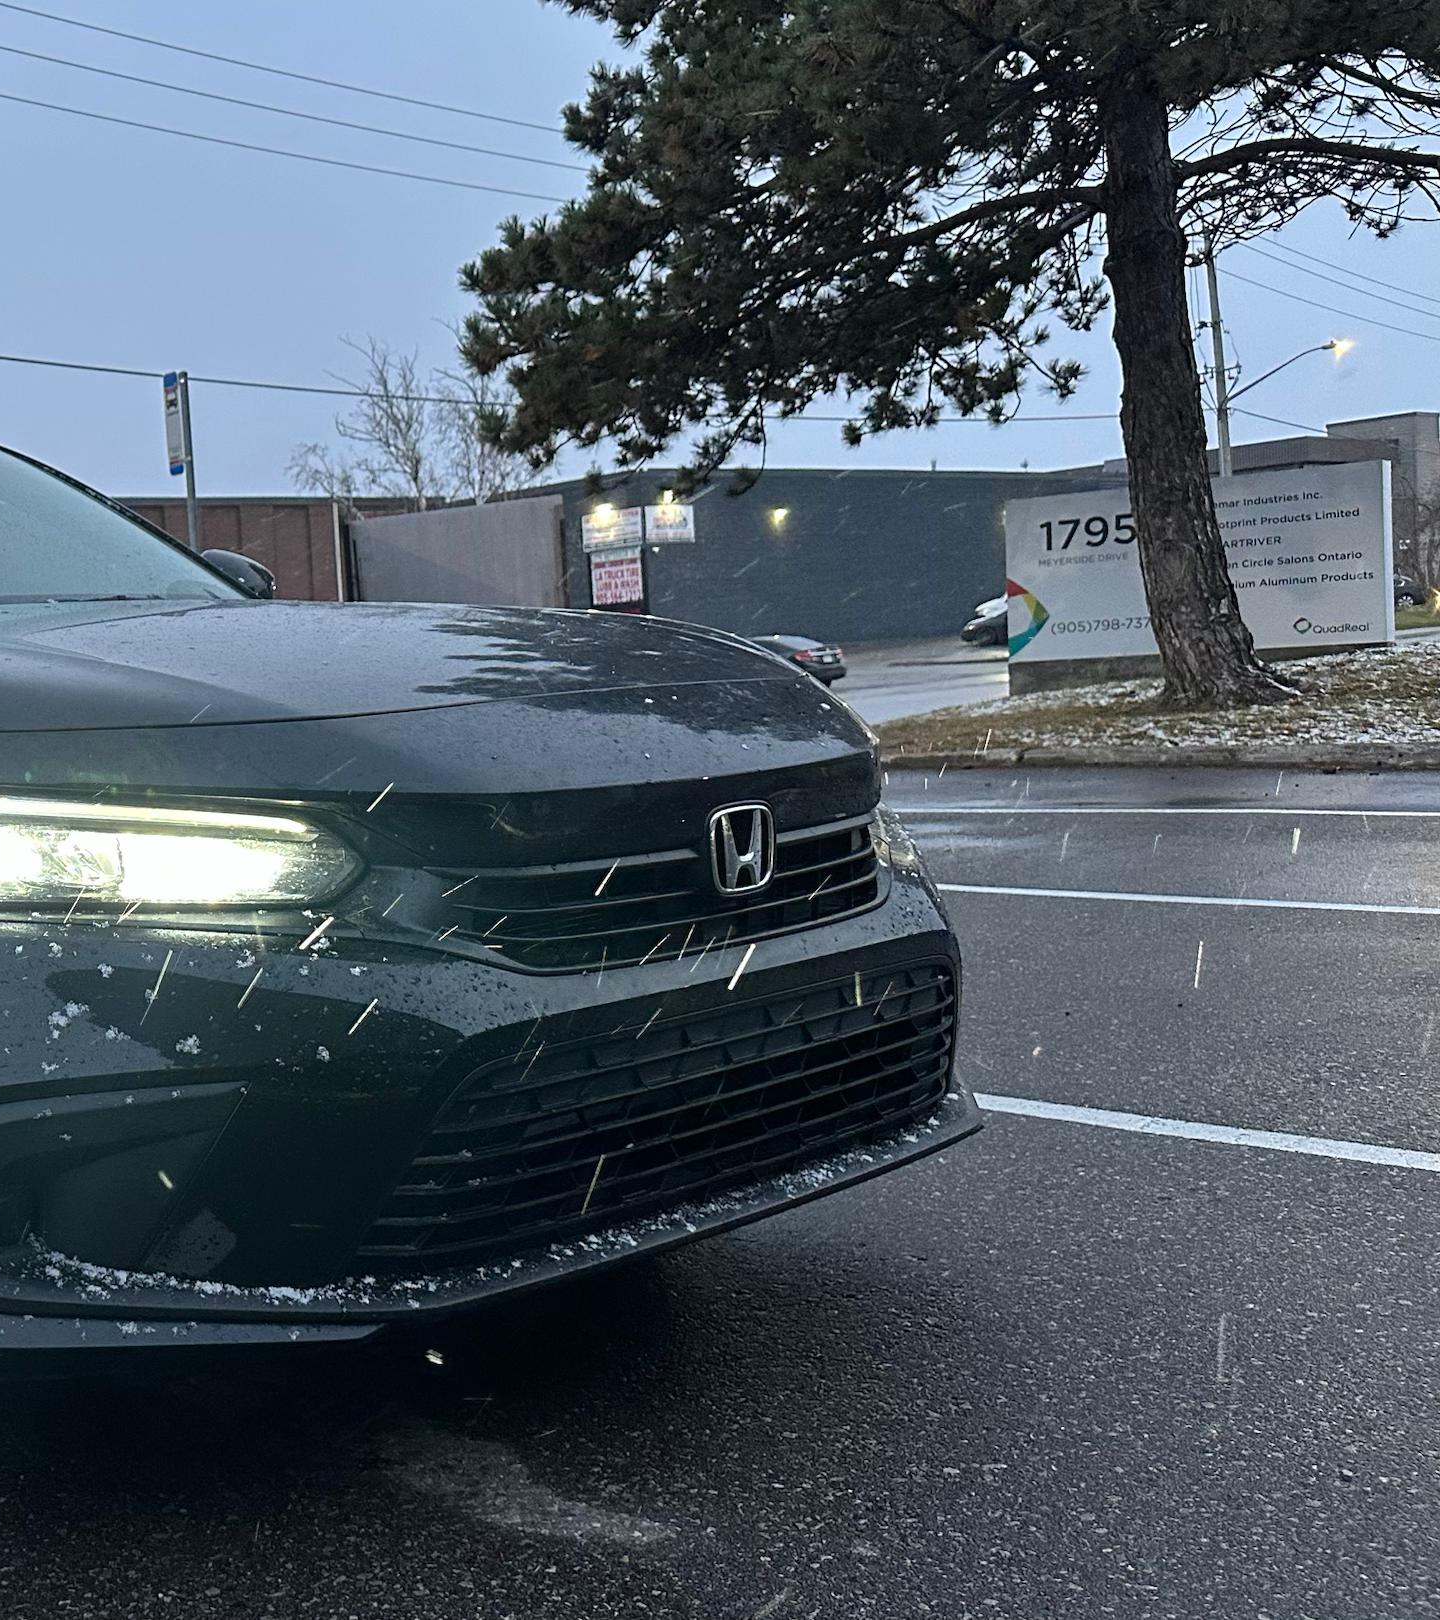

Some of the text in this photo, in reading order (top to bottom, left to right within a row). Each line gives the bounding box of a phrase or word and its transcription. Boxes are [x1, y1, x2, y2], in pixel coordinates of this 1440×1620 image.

[1243, 494, 1299, 507] Industries
[1302, 491, 1323, 500] Inc.
[1218, 508, 1360, 530] otprint Products Limited
[1040, 514, 1137, 551] 1795
[1223, 536, 1282, 549] ARTRIVER
[1097, 551, 1129, 562] DRIVE
[1242, 558, 1274, 568] Circle
[1277, 556, 1314, 566] Salons
[1318, 551, 1363, 562] Ontario
[1260, 577, 1318, 588] Aluminum
[1321, 572, 1374, 583] Products
[1051, 616, 1152, 635] (905)798-737
[1312, 622, 1370, 634] QuadReal
